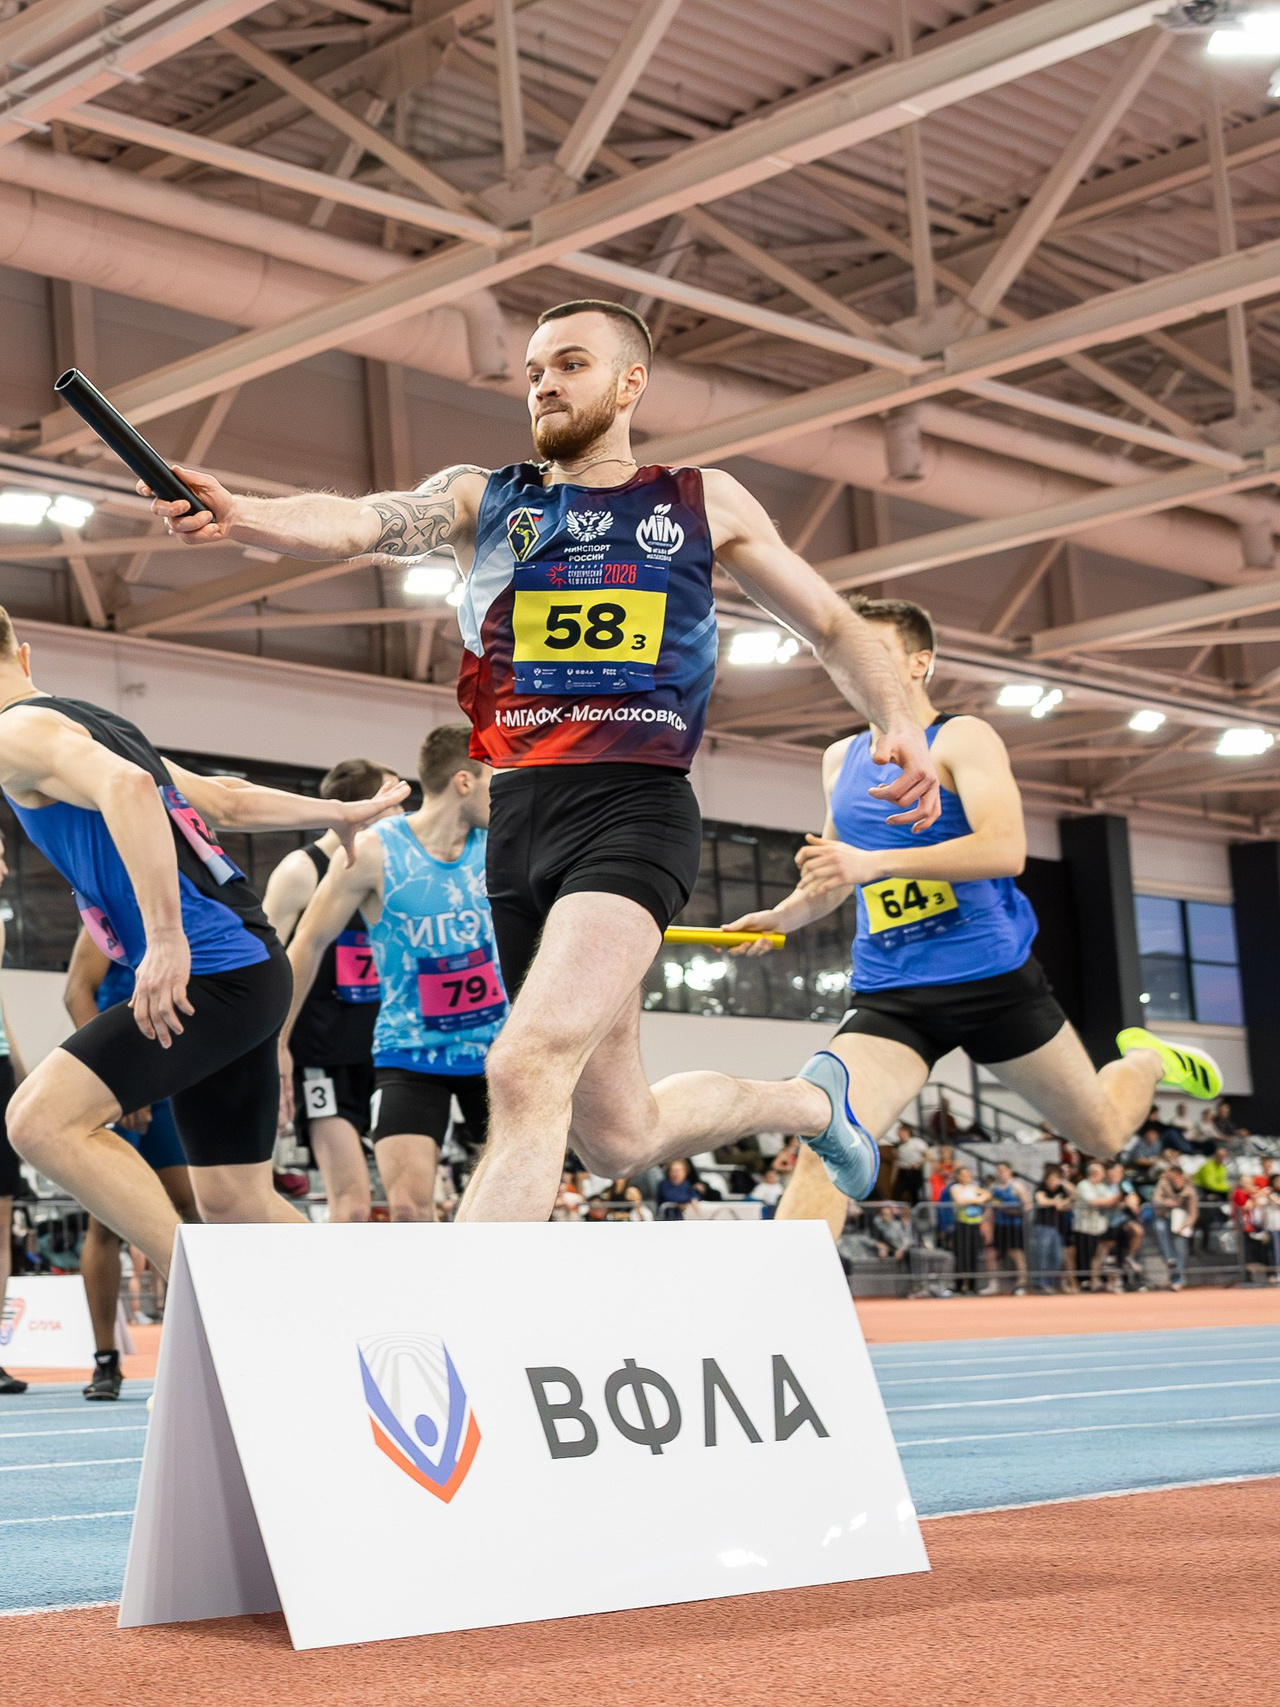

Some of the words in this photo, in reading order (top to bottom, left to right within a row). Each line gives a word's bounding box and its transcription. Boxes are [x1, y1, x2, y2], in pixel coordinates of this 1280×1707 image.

[563, 544, 611, 554] МИНСПОРТ
[568, 553, 605, 563] РОССИИ
[543, 602, 626, 650] 58
[631, 634, 647, 650] 3
[880, 881, 929, 919] 64
[933, 892, 945, 905] 3
[355, 954, 378, 979] 7
[442, 976, 487, 1007] 79
[311, 1086, 326, 1109] 3
[525, 1354, 831, 1459] ВФЛА
